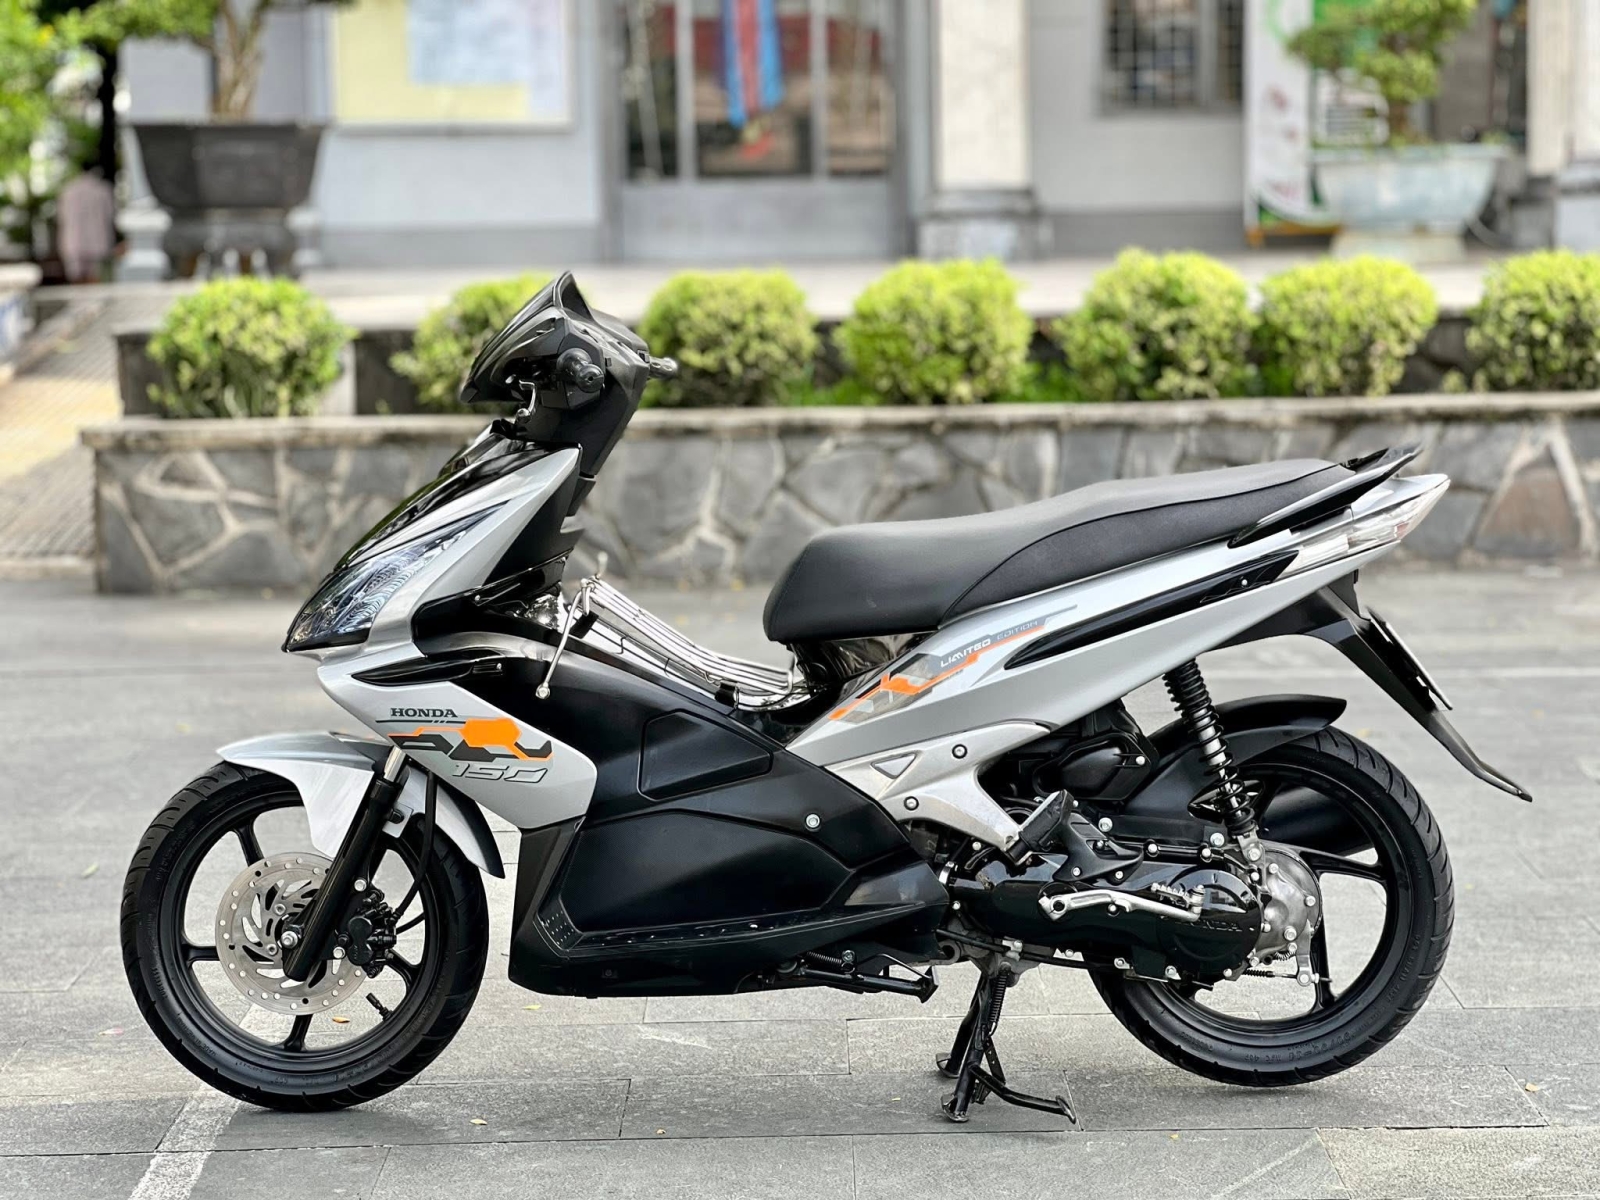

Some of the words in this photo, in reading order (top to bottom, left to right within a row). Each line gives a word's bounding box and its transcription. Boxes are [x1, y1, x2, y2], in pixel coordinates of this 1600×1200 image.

[940, 638, 992, 668] LIMITED
[997, 619, 1039, 641] EDITION
[390, 707, 459, 718] HONDA
[452, 763, 549, 784] 150
